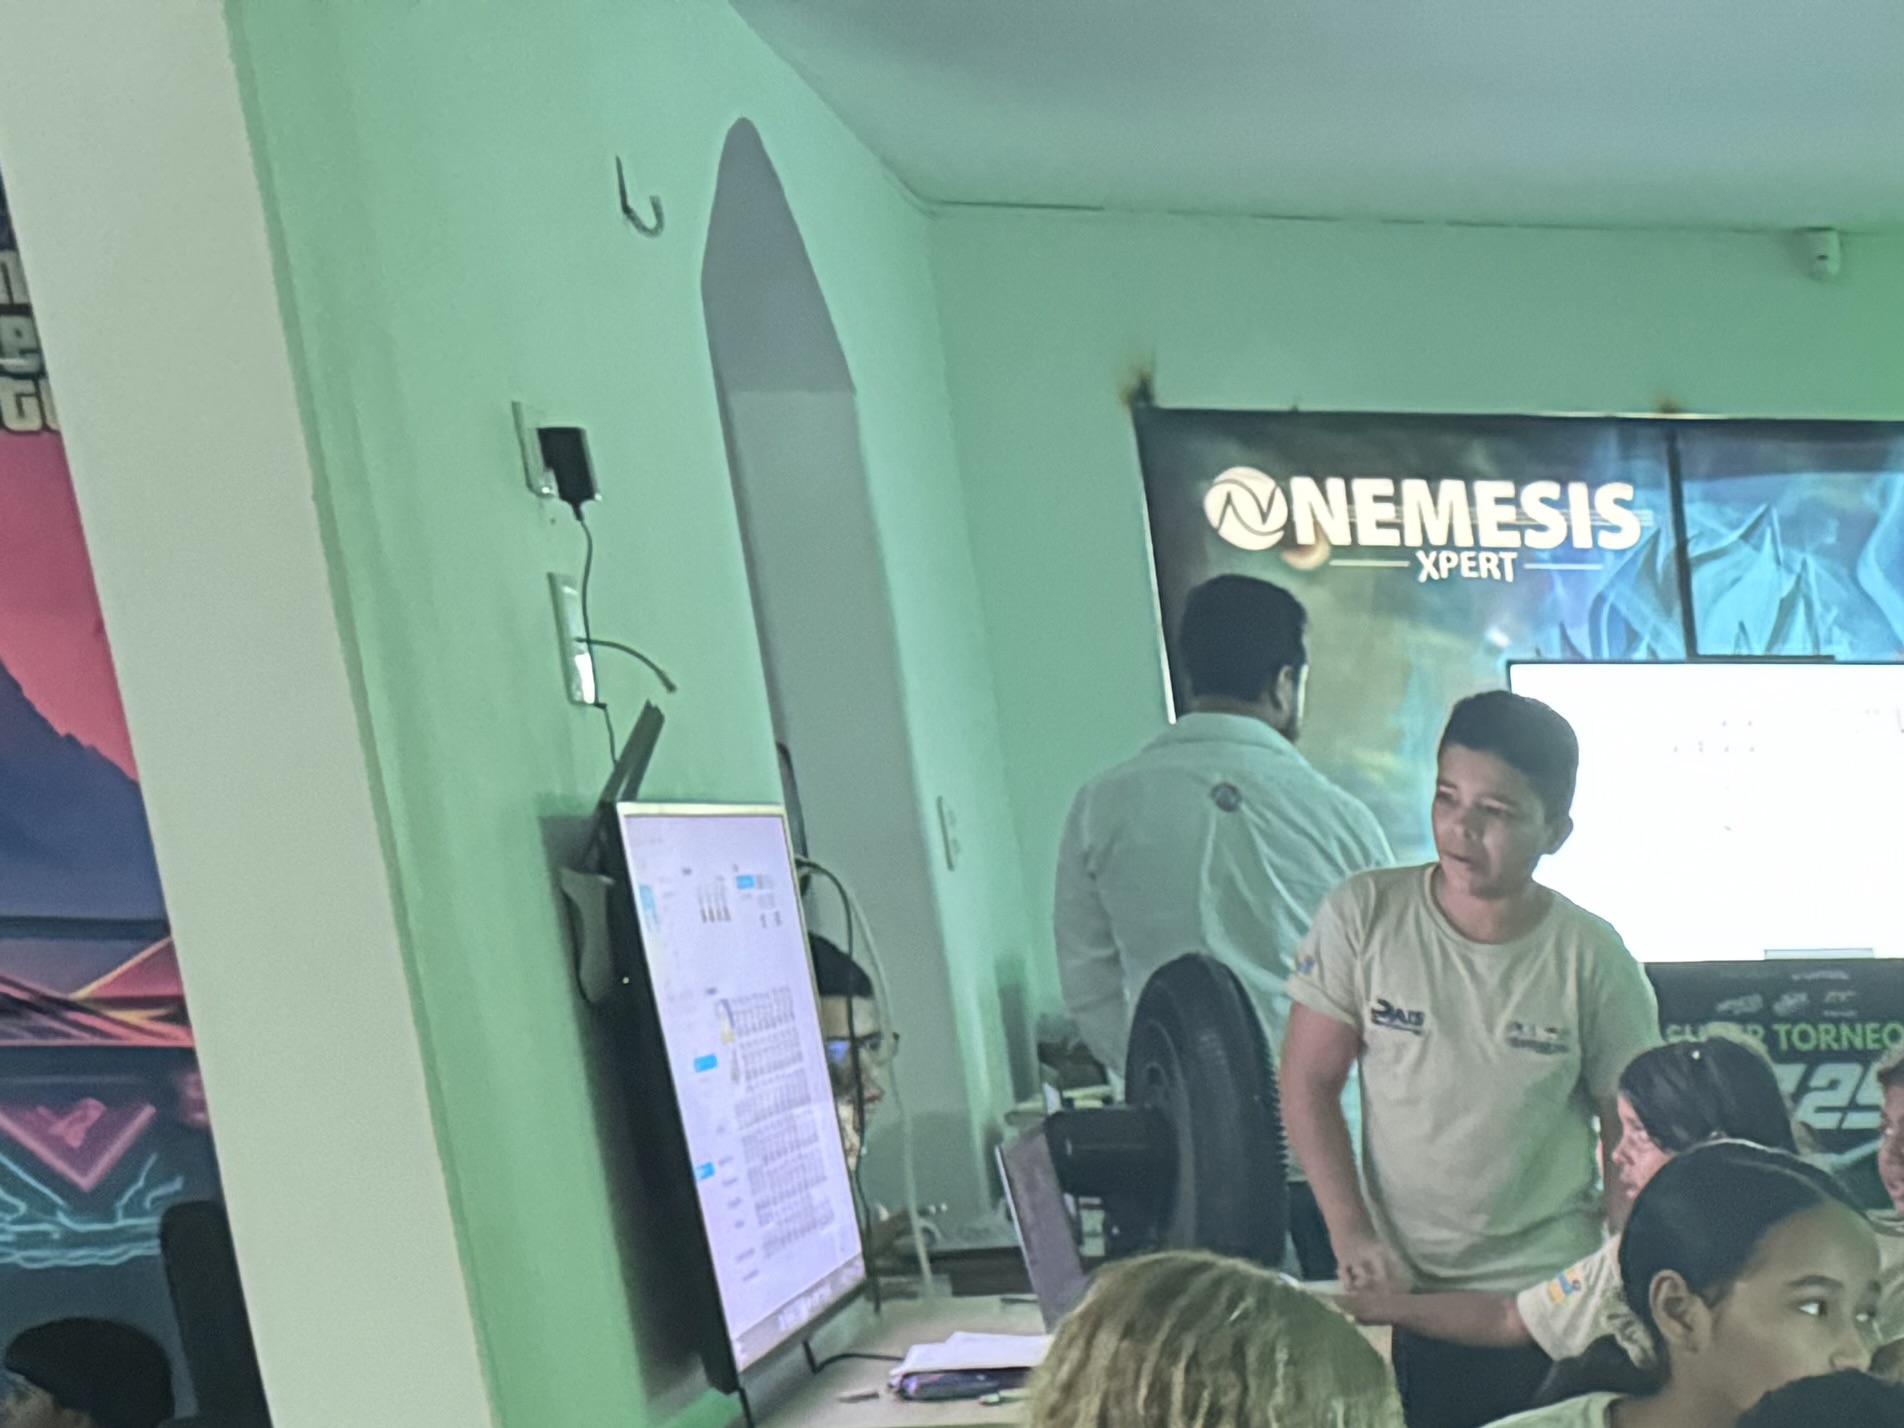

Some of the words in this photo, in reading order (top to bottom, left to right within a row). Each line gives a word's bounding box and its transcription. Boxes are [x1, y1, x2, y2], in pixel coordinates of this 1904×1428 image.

[1290, 476, 1643, 551] NEMESIS
[1415, 550, 1519, 583] XPERT
[1665, 1022, 1766, 1048] SUR
